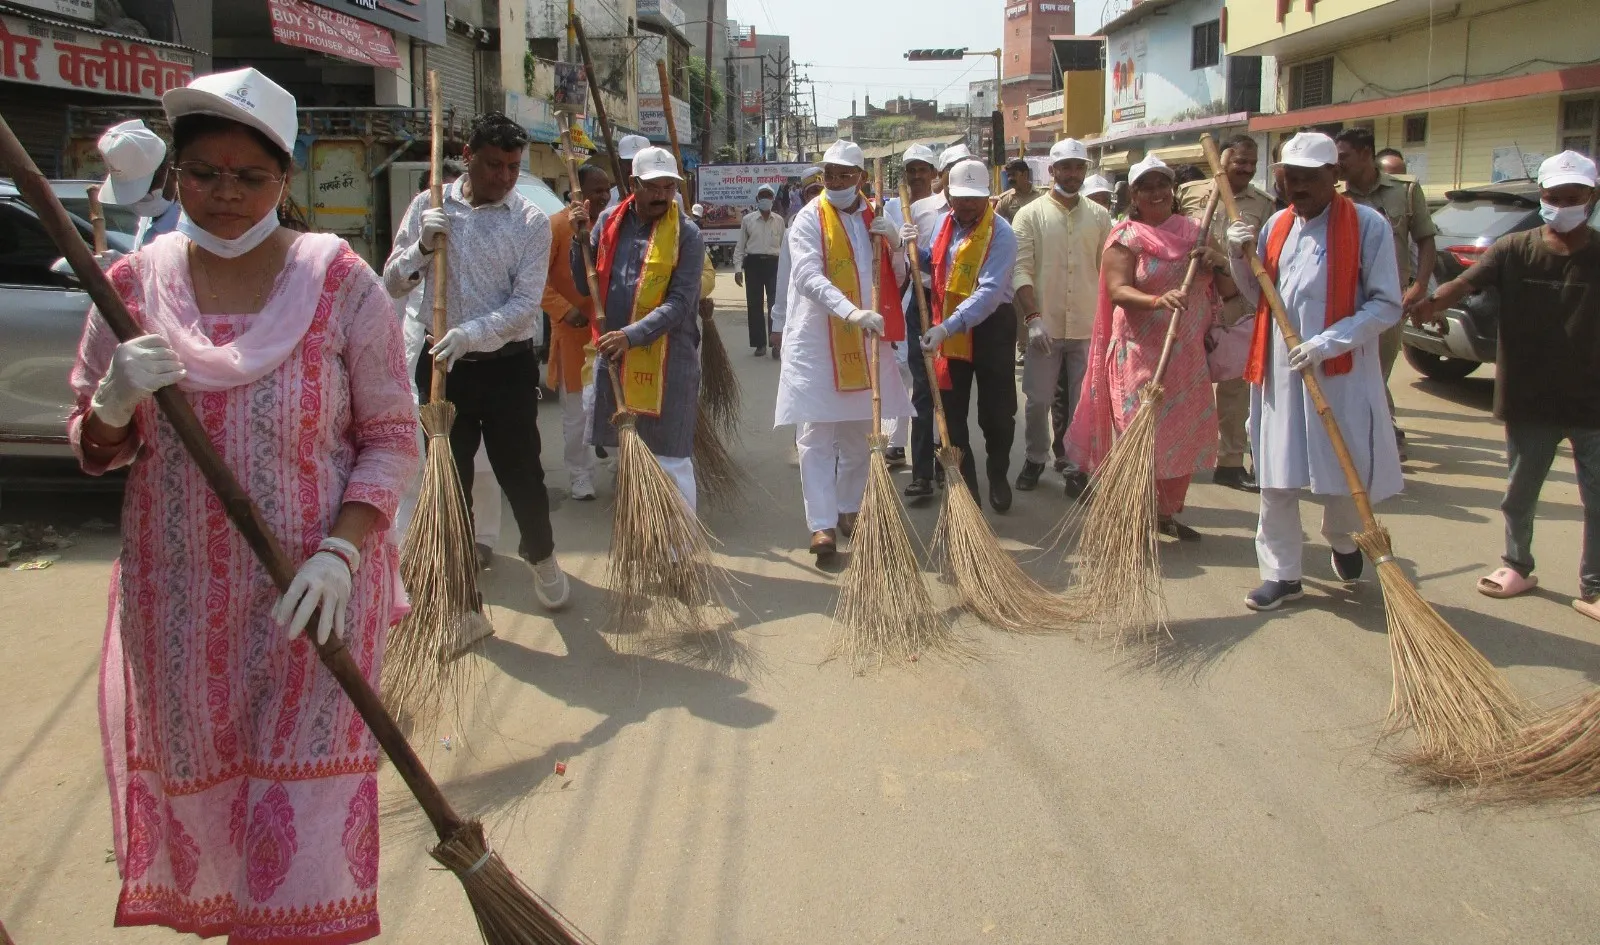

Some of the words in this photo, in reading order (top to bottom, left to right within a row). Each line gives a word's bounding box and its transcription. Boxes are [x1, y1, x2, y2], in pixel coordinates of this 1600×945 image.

[272, 8, 302, 26] BUY
[307, 17, 315, 30] 5
[273, 27, 300, 41] SHIRT
[573, 146, 589, 155] OPEN
[634, 371, 654, 386] राम
